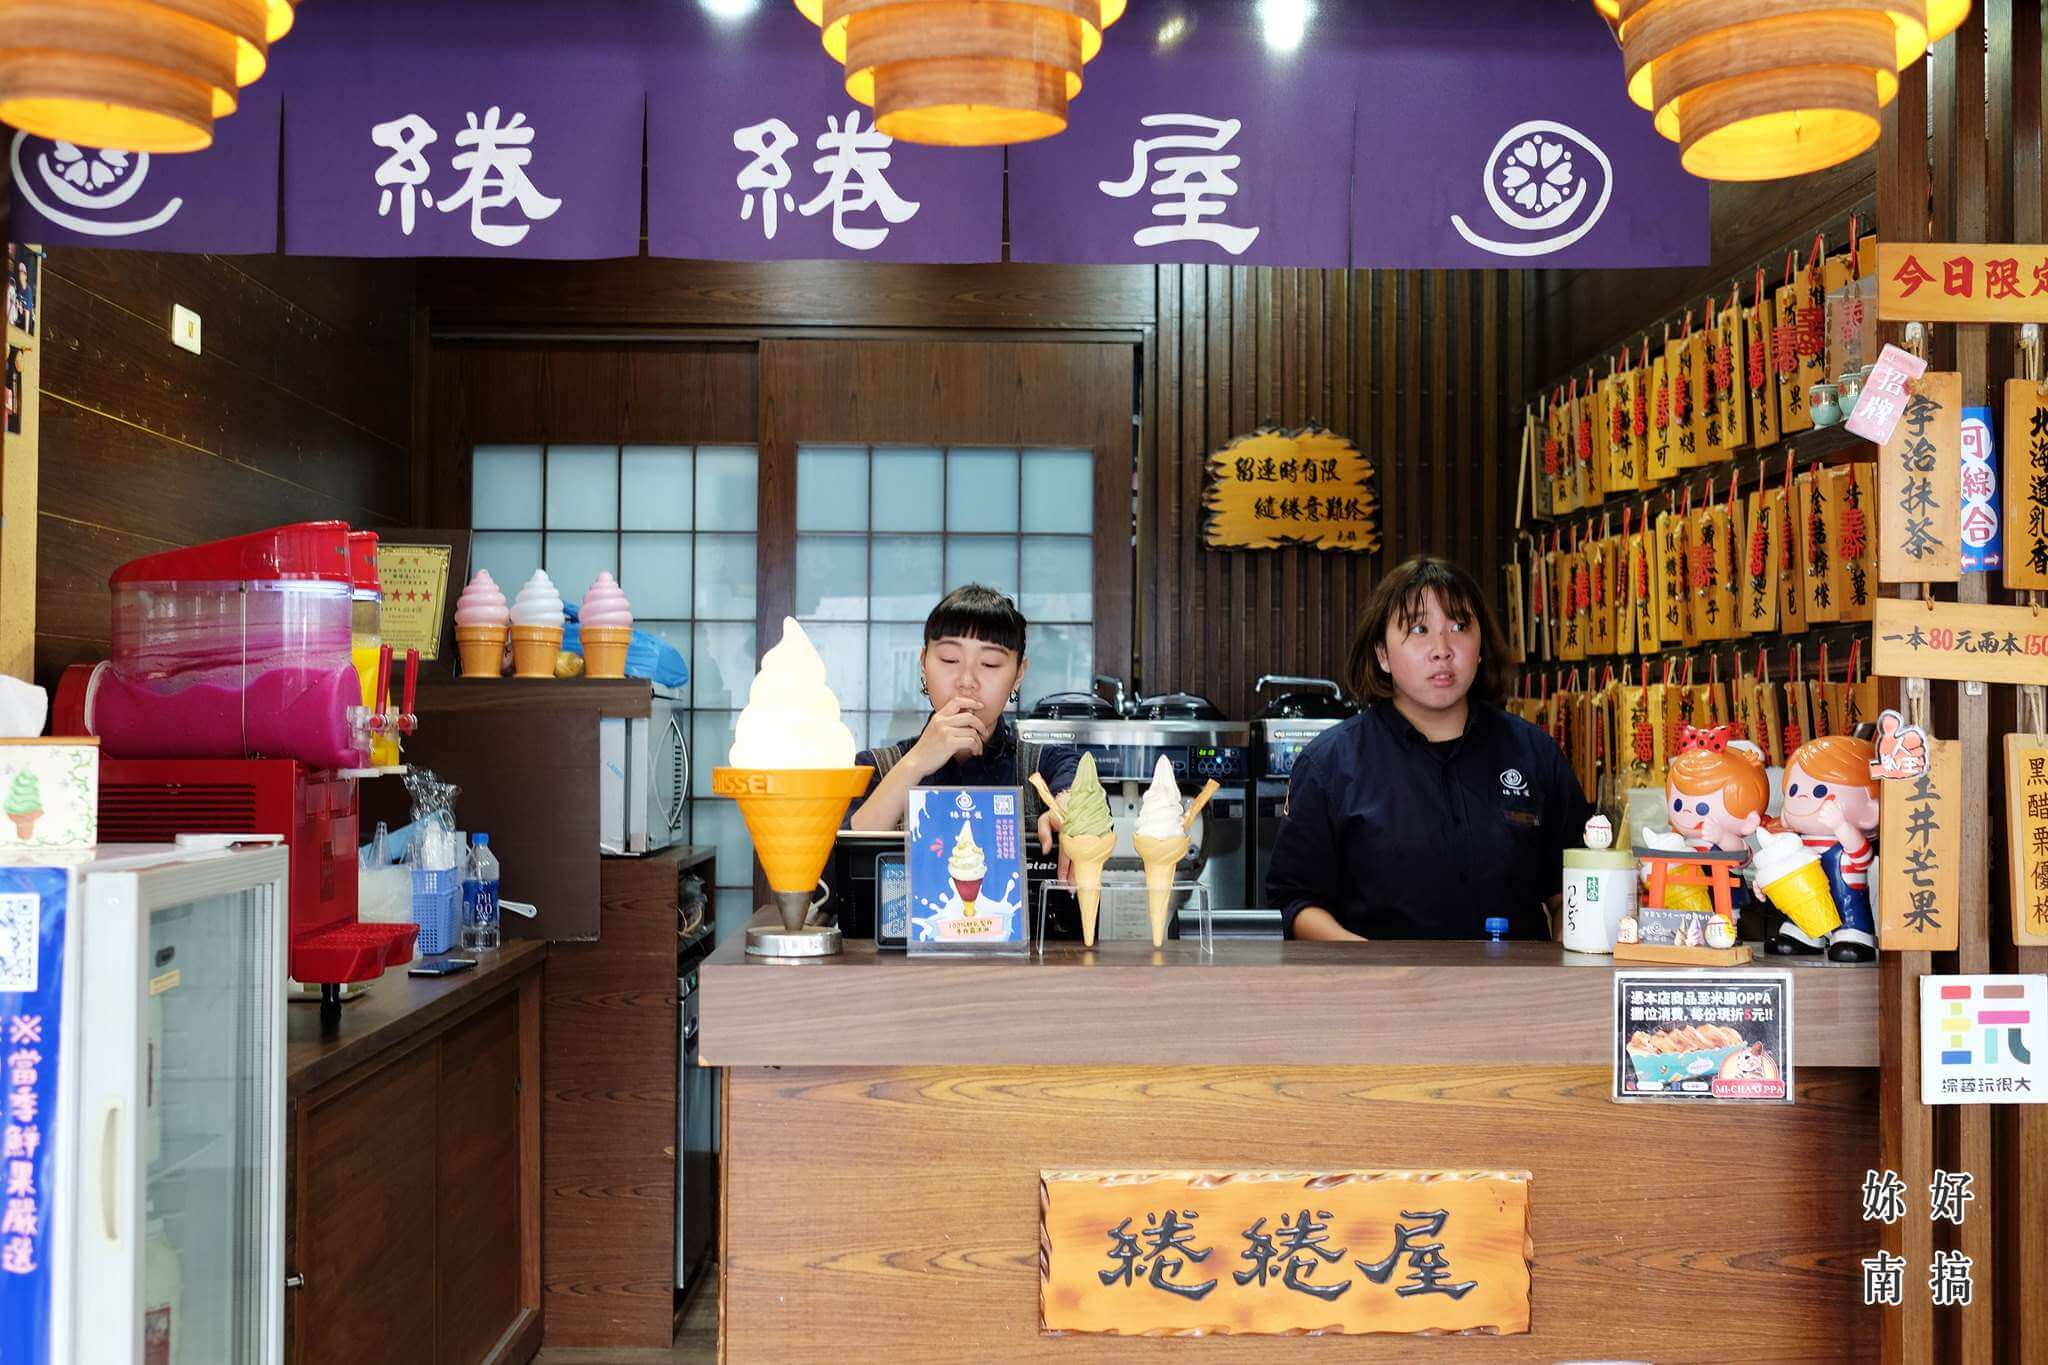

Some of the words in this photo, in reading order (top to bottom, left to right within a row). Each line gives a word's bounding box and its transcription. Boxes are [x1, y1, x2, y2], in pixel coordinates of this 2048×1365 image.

[1859, 366, 1909, 426] 招牌
[1899, 394, 1944, 561] 宇治抹茶
[1941, 1077, 2031, 1093] 綜藝玩很大
[1098, 1208, 1478, 1301] 綣綣屋
